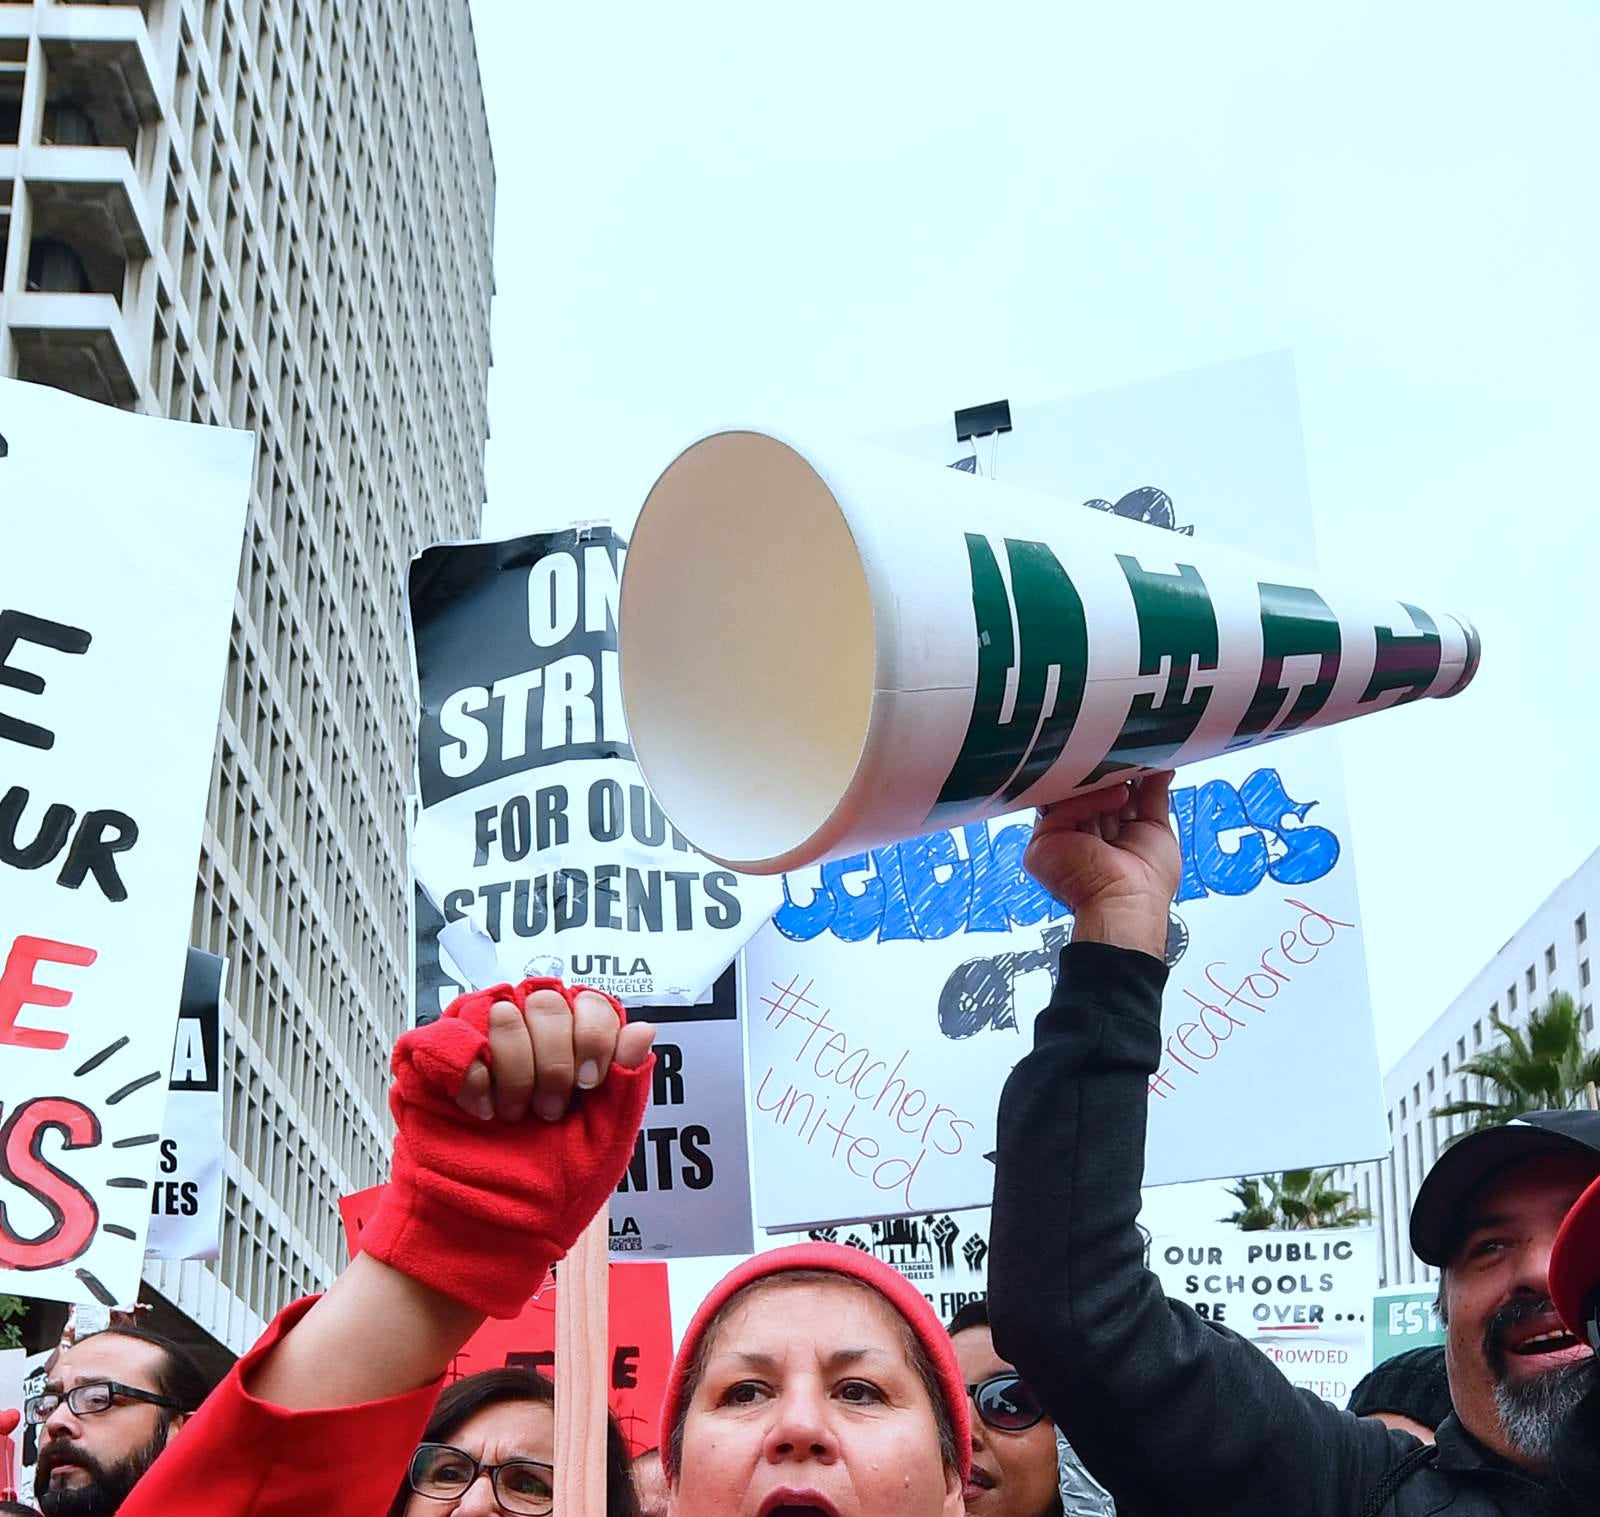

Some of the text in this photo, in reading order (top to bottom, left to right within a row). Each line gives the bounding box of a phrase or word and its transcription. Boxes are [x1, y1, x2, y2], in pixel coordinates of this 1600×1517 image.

[439, 650, 629, 778] STRI
[473, 779, 700, 866] FOR OU
[571, 955, 652, 976] UTLA
[1147, 899, 1355, 1099] #redfored
[760, 974, 974, 1155] #teachers
[756, 1067, 926, 1209] united
[1164, 1241, 1353, 1265] OUR PUBLIC
[1185, 1274, 1334, 1295] SCHOOLS
[1195, 1303, 1227, 1322] RE
